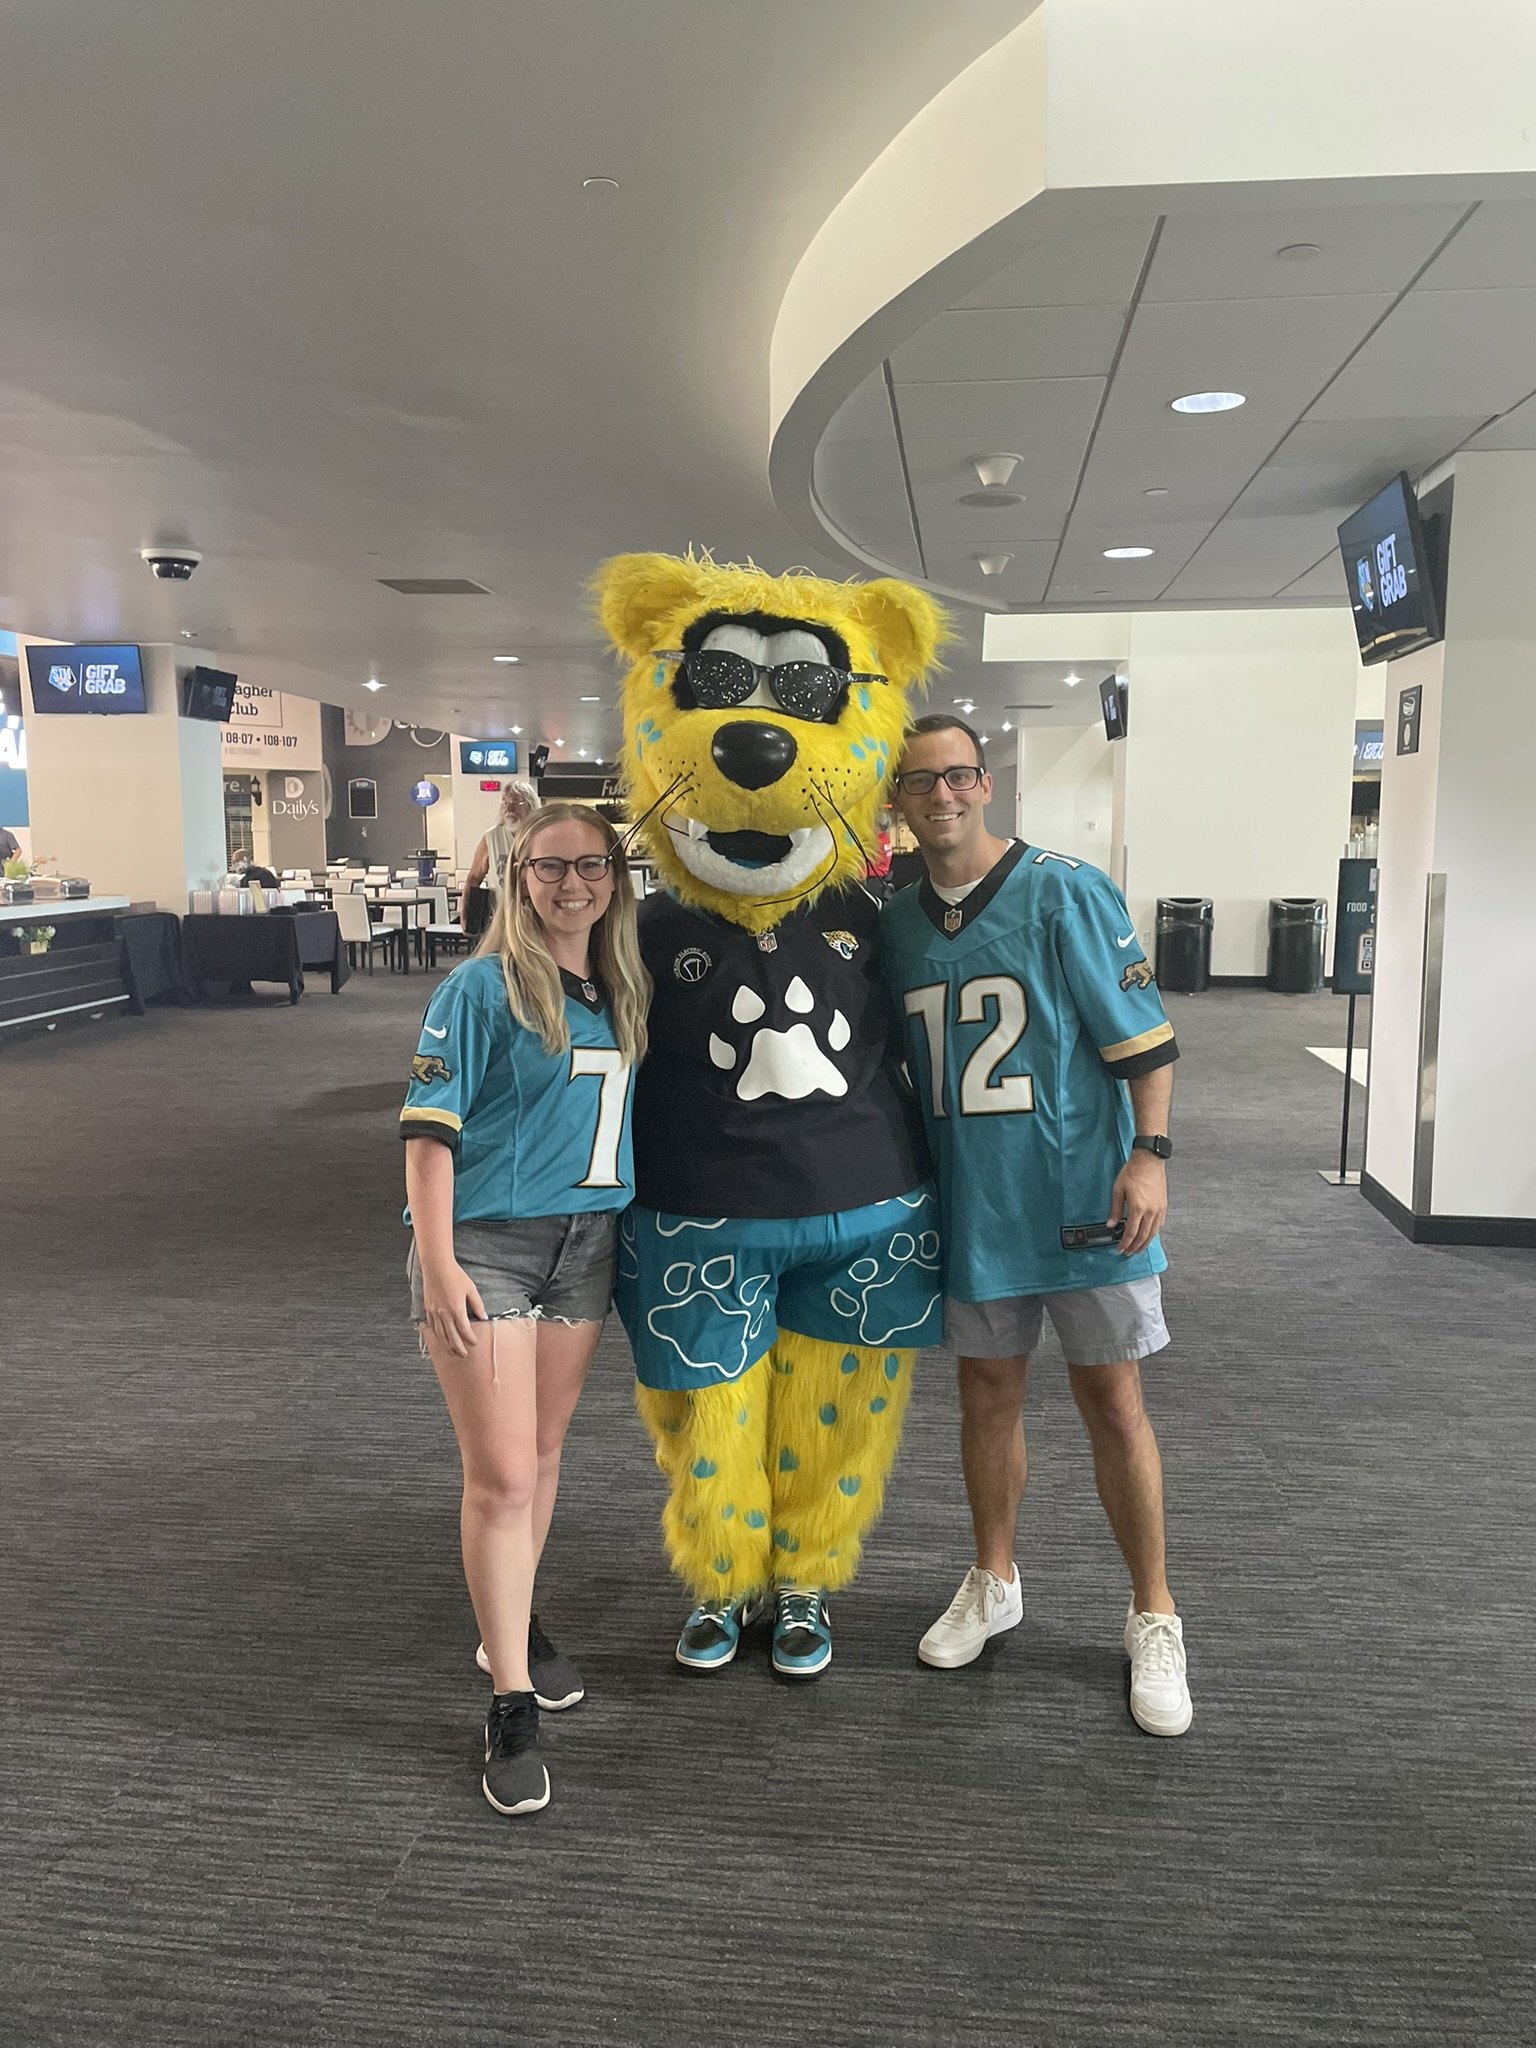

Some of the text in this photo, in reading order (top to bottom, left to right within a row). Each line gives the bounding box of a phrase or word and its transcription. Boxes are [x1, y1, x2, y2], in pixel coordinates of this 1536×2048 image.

[1376, 532, 1397, 576] GIFT
[1380, 564, 1408, 608] GRAB
[85, 664, 119, 680] GIFT
[84, 678, 127, 695] GRAB
[234, 683, 274, 699] agher
[263, 734, 298, 748] 108-107
[223, 780, 245, 792] re.
[272, 799, 320, 822] Daily's
[1346, 902, 1368, 912] FOOD
[567, 1045, 633, 1189] 7
